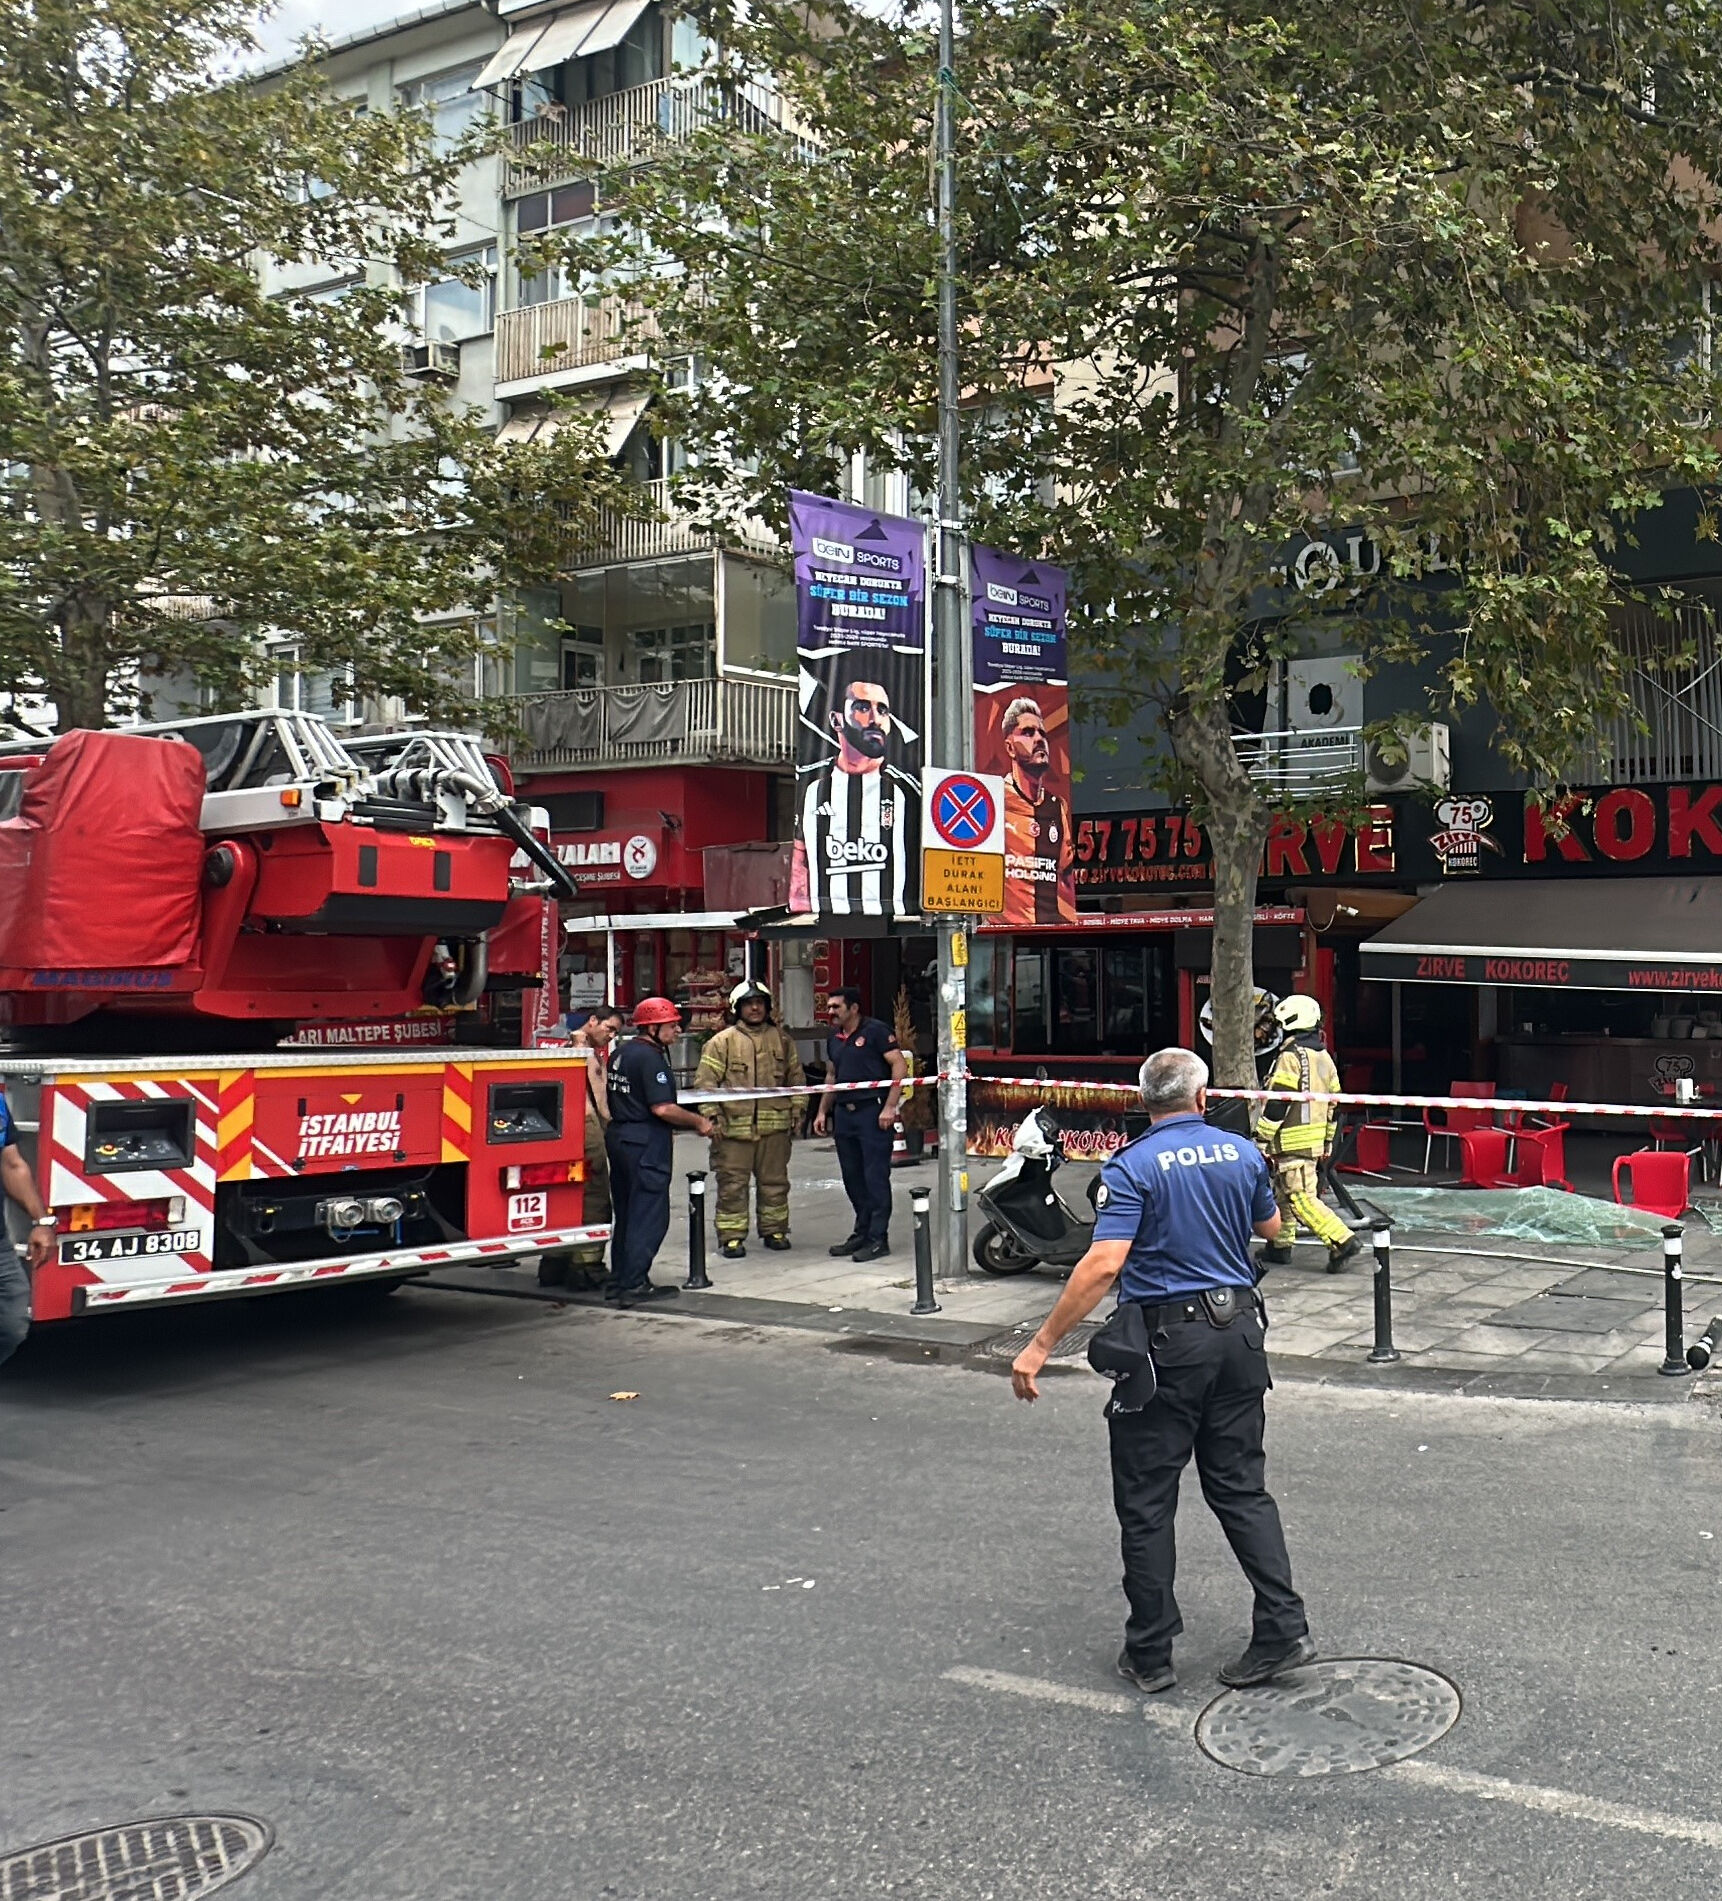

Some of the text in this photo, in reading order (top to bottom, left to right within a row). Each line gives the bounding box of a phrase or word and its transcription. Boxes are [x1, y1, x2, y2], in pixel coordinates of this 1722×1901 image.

[857, 552, 899, 570] SPORTS
[810, 584, 908, 607] SÜPER BİR SEZON
[1019, 595, 1049, 611] SPORTS
[831, 603, 886, 620] BURADA!
[1002, 642, 1041, 656] BURADA!
[1450, 807, 1472, 824] 75
[1077, 814, 1201, 861] 57 75 75
[826, 834, 888, 862] beko
[951, 854, 976, 867] İETT
[943, 869, 984, 880] DURAK
[947, 883, 982, 895] ALANI
[928, 897, 1000, 910] BAŞLANGICI
[327, 1024, 391, 1044] MALTEPE
[394, 1019, 441, 1043] ŞUBESİ
[516, 1196, 541, 1214] 112
[73, 1231, 200, 1261] 34 AJ 8308
